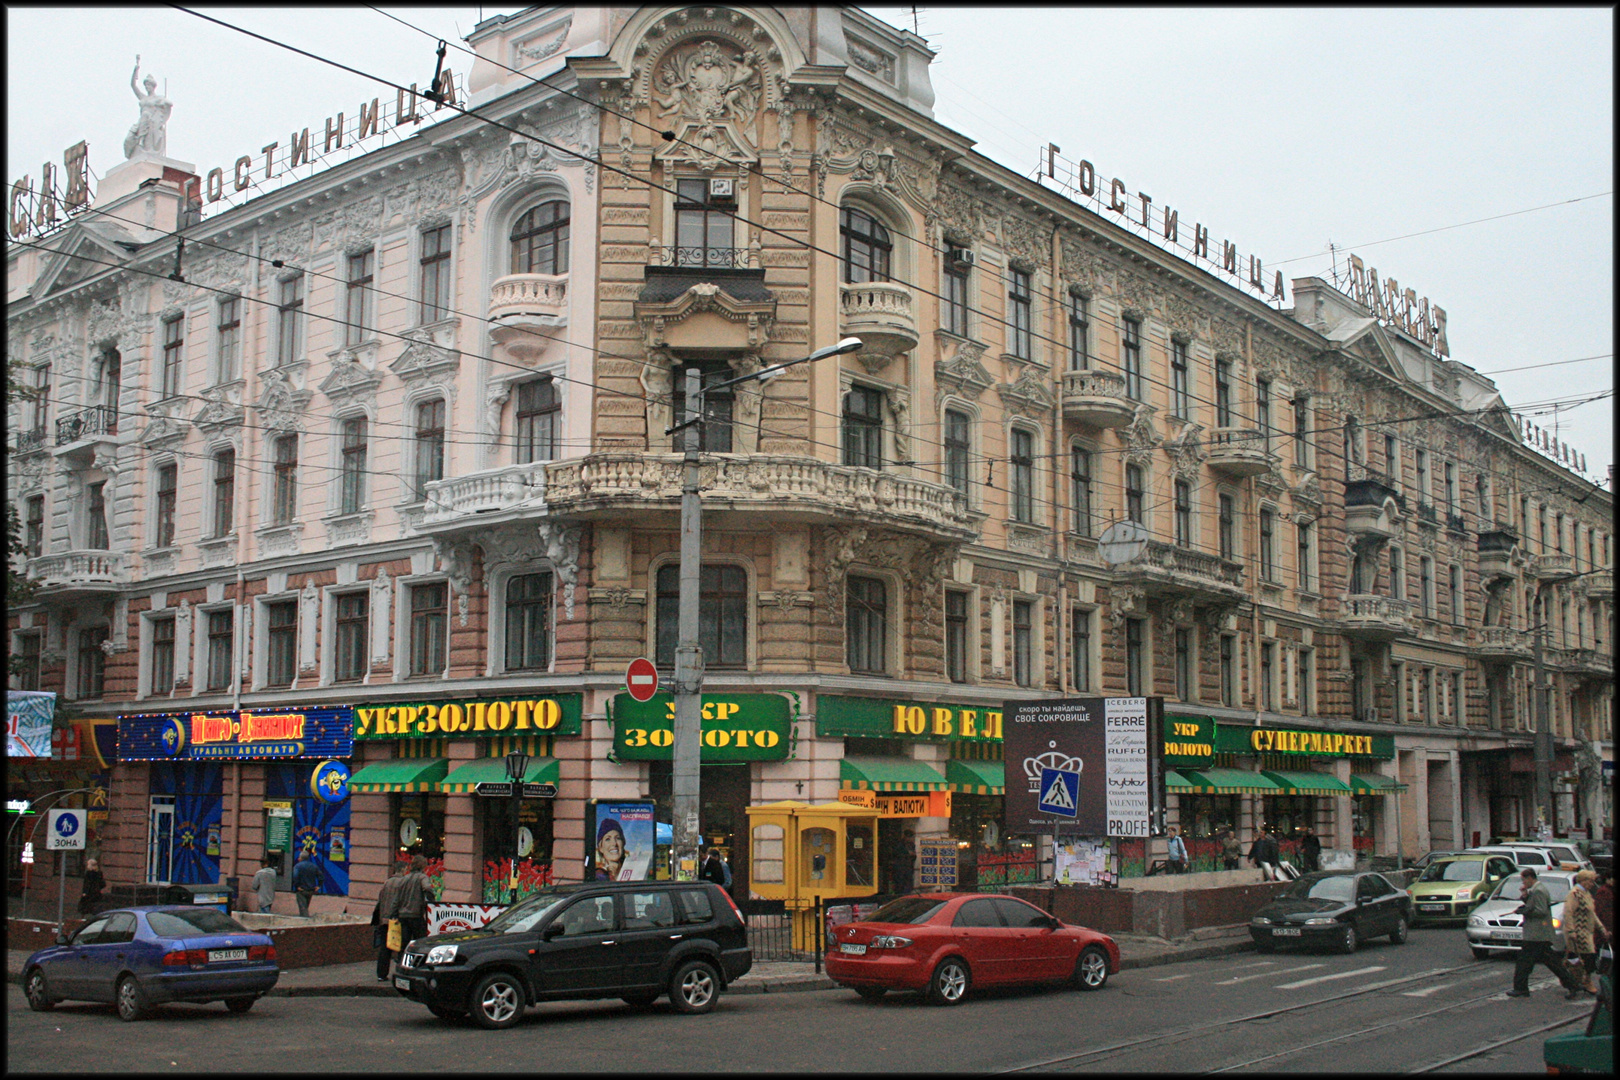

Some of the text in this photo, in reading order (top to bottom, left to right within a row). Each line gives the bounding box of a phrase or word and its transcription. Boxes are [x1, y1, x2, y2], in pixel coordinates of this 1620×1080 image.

[183, 67, 456, 214] ГОСТИНИЦА
[1048, 142, 1286, 302] ГОСТИНИЦА
[1350, 252, 1450, 358] ПАССАЖ
[1019, 705, 1040, 713] скоро
[1052, 703, 1086, 712] найдешь
[356, 699, 561, 735] УКРЗОЛОТО
[893, 704, 1003, 739] ЮВЕЛ
[1015, 713, 1090, 722] СВОЕ СОКРОВИЩЕ
[1107, 715, 1146, 726] FERRÉ
[1173, 722, 1200, 737] УКР
[624, 728, 779, 748] ЗООТО
[1251, 729, 1373, 755] СУПЕРМАРКЕТ
[238, 744, 296, 755] АВТОМАТИ
[1107, 747, 1146, 755] RUFFO
[842, 795, 865, 803] ОБМІН
[1109, 799, 1148, 807] VALENTINO
[893, 799, 925, 815] ВАЛЮТИ
[1109, 819, 1148, 836] PR.OFF
[54, 839, 78, 847] ЗОНА
[435, 910, 477, 923] КОНТИНЕНТ
